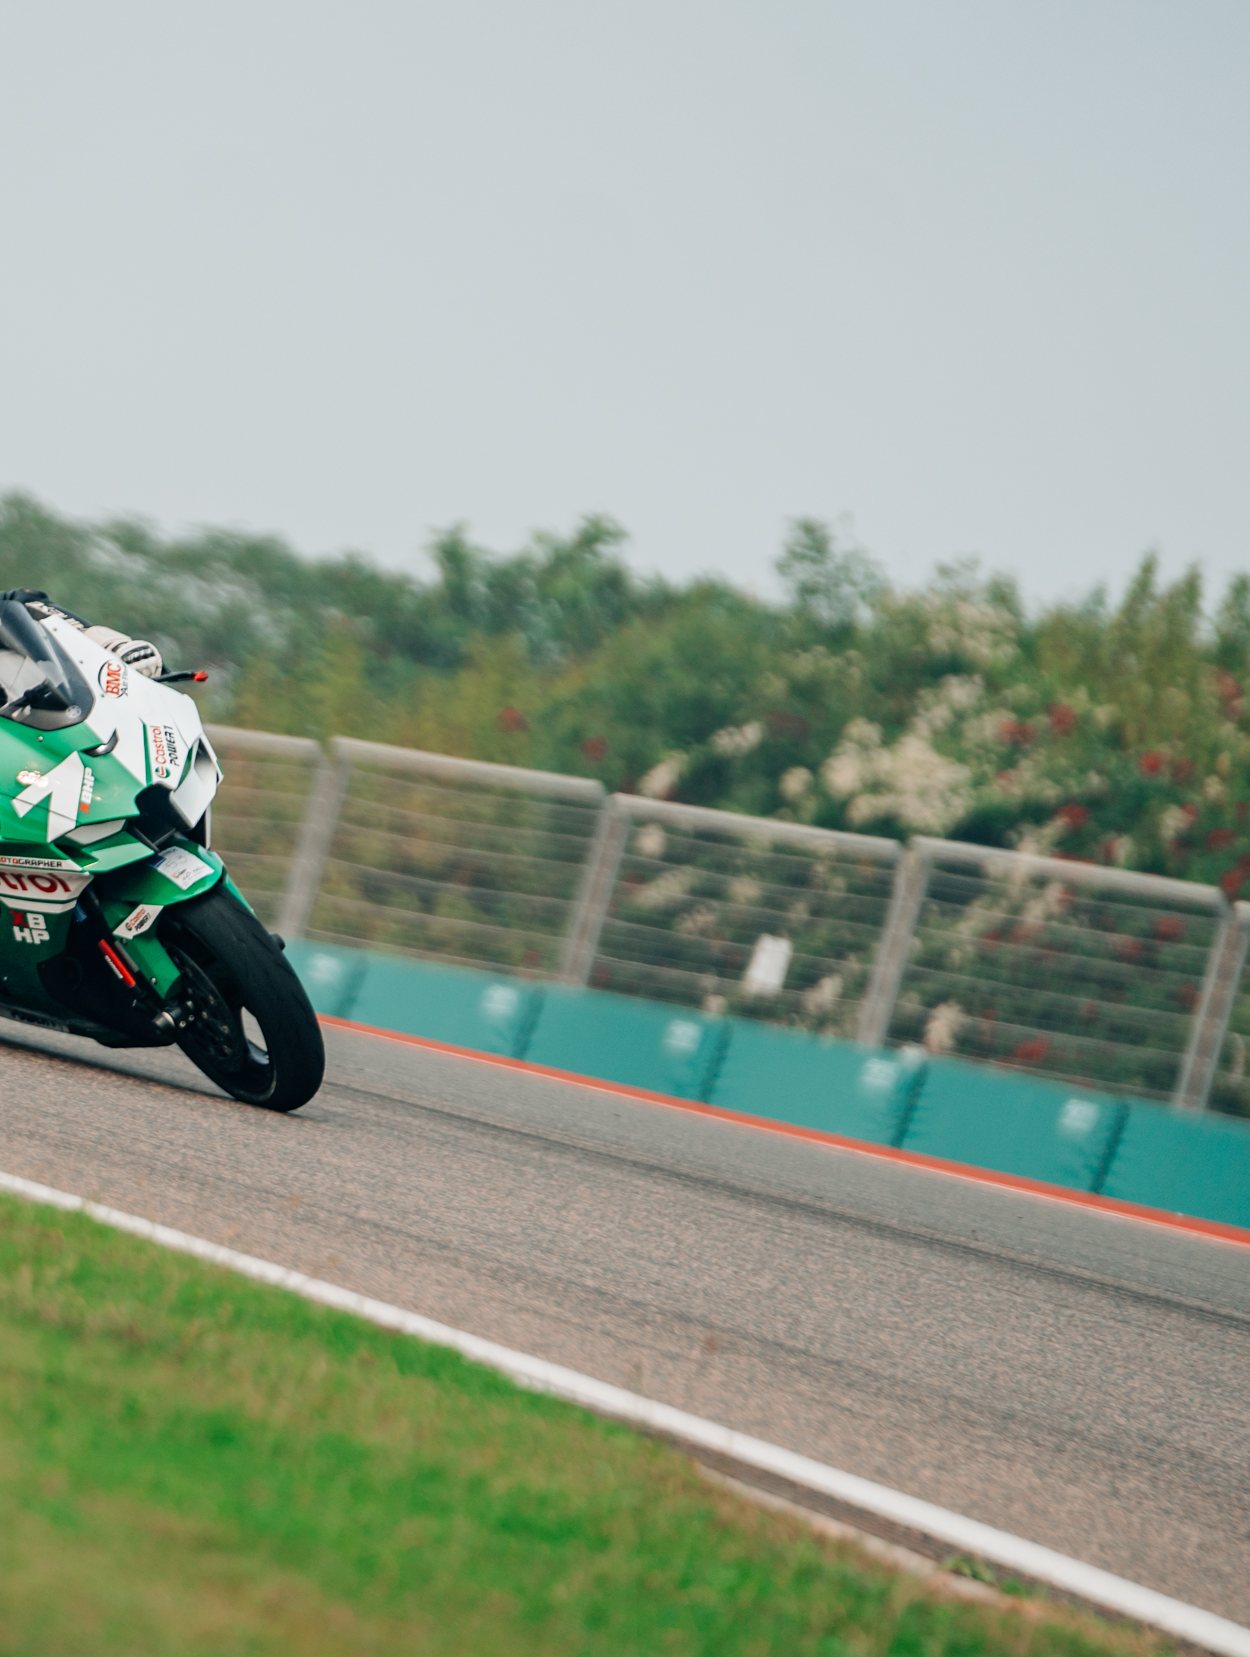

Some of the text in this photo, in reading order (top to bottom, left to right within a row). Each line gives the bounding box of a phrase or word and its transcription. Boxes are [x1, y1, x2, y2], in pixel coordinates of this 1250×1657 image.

[106, 663, 122, 696] BMC
[150, 725, 167, 764] Castrol
[79, 766, 95, 814] XBHP
[10, 910, 46, 930] XB
[13, 925, 50, 944] HP
